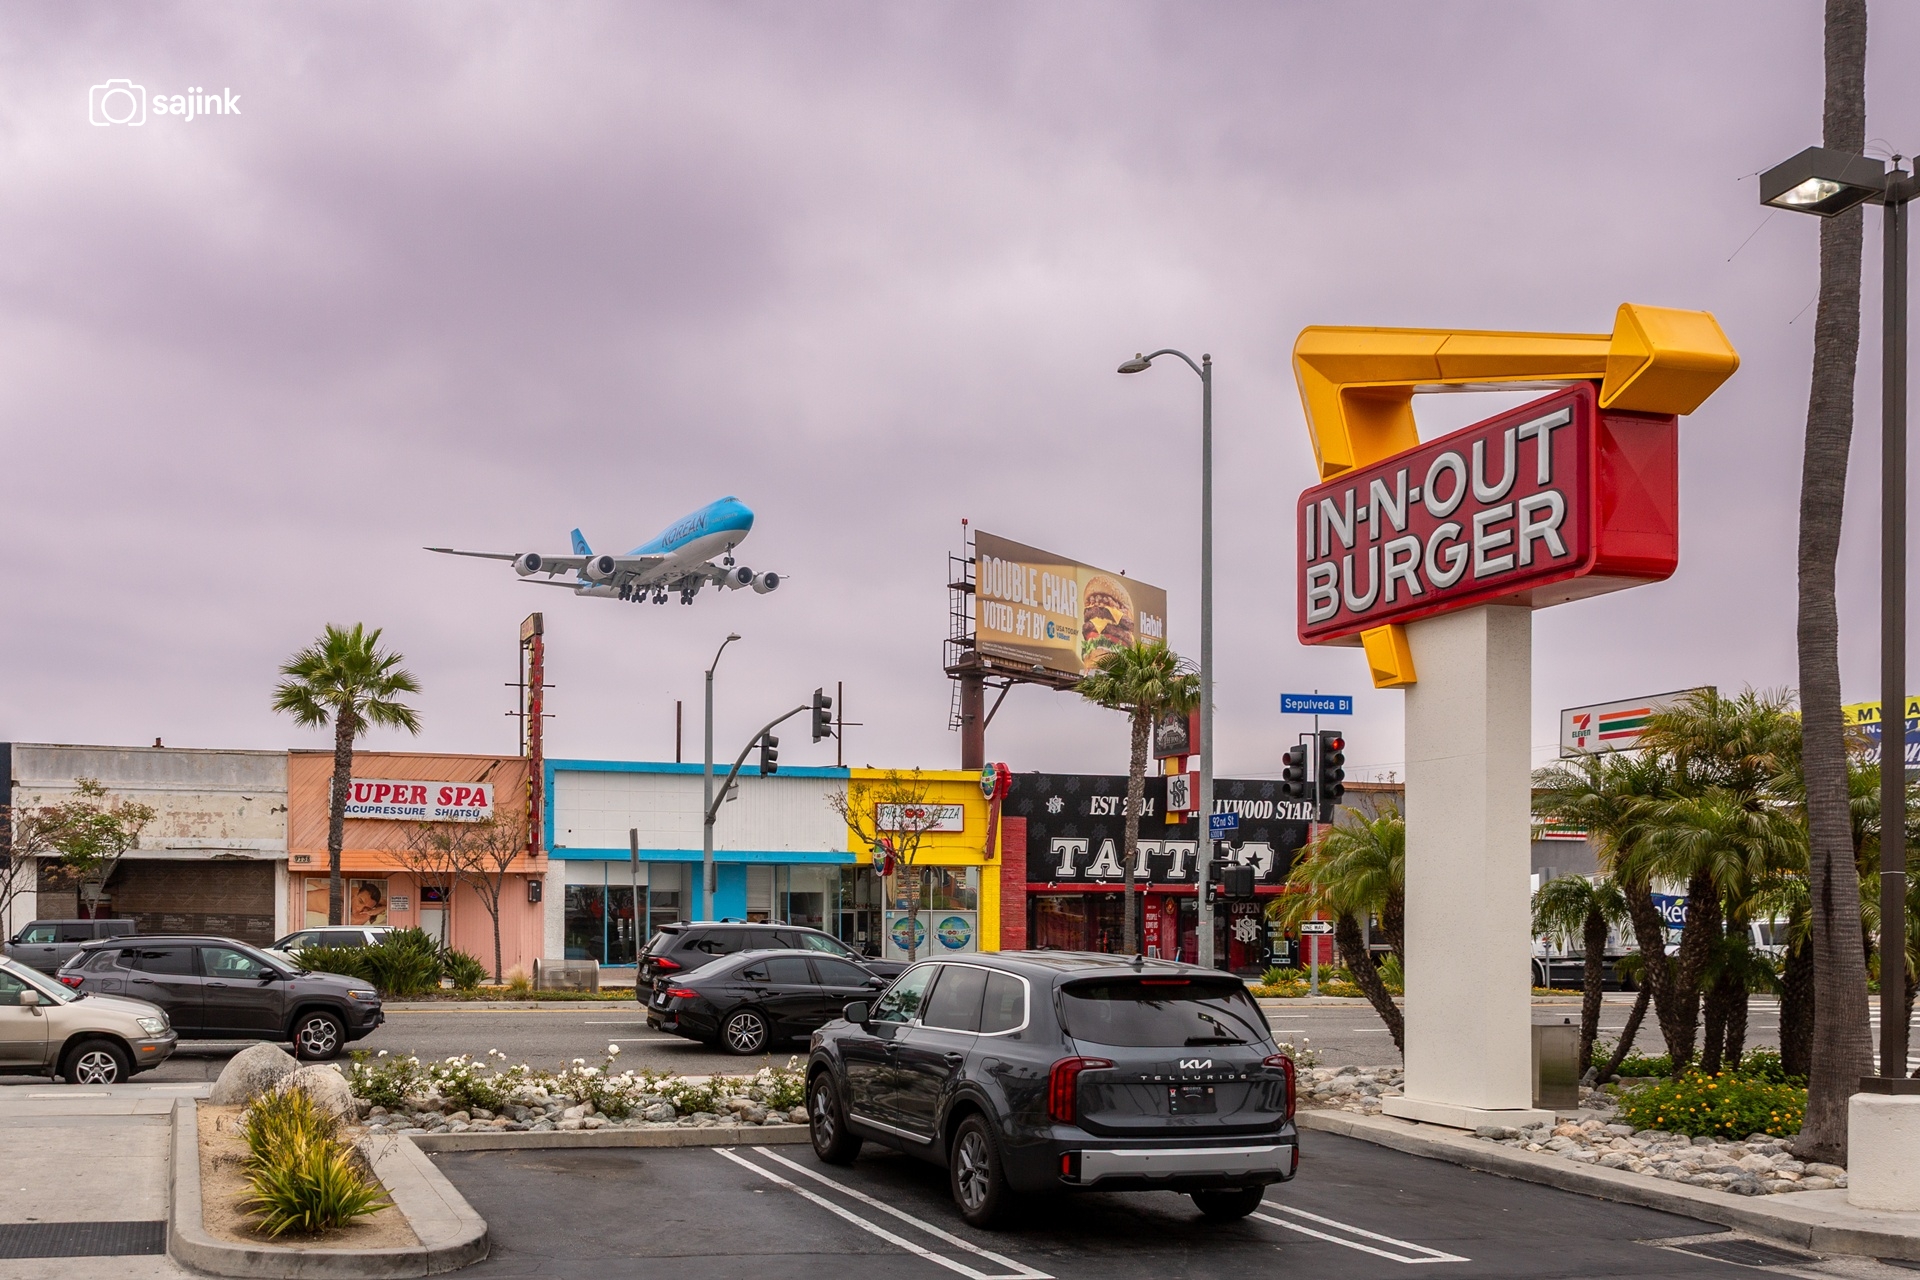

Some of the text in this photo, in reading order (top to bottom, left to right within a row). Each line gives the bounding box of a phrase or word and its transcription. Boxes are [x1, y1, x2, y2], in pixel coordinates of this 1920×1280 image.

[1306, 407, 1571, 561] IN-N-OUT
[661, 513, 707, 548] KOREAN
[1306, 490, 1567, 624] BURGER
[982, 554, 1078, 618] DOUBLE CHAR
[983, 600, 1046, 641] VOTED #1 BY
[1056, 625, 1065, 633] USA
[1140, 611, 1162, 639] Habit
[1285, 698, 1349, 711] Sepulveda Bl
[437, 786, 488, 807] SPA
[1089, 796, 1154, 816] EST 204
[345, 805, 480, 818] ACUPRESSURE SHIATSU
[1275, 801, 1320, 820] STAR
[1212, 815, 1234, 827] 92nd St
[1050, 837, 1275, 880] TATTO
[1232, 902, 1260, 914] OPEN
[1180, 1059, 1212, 1069] KIA
